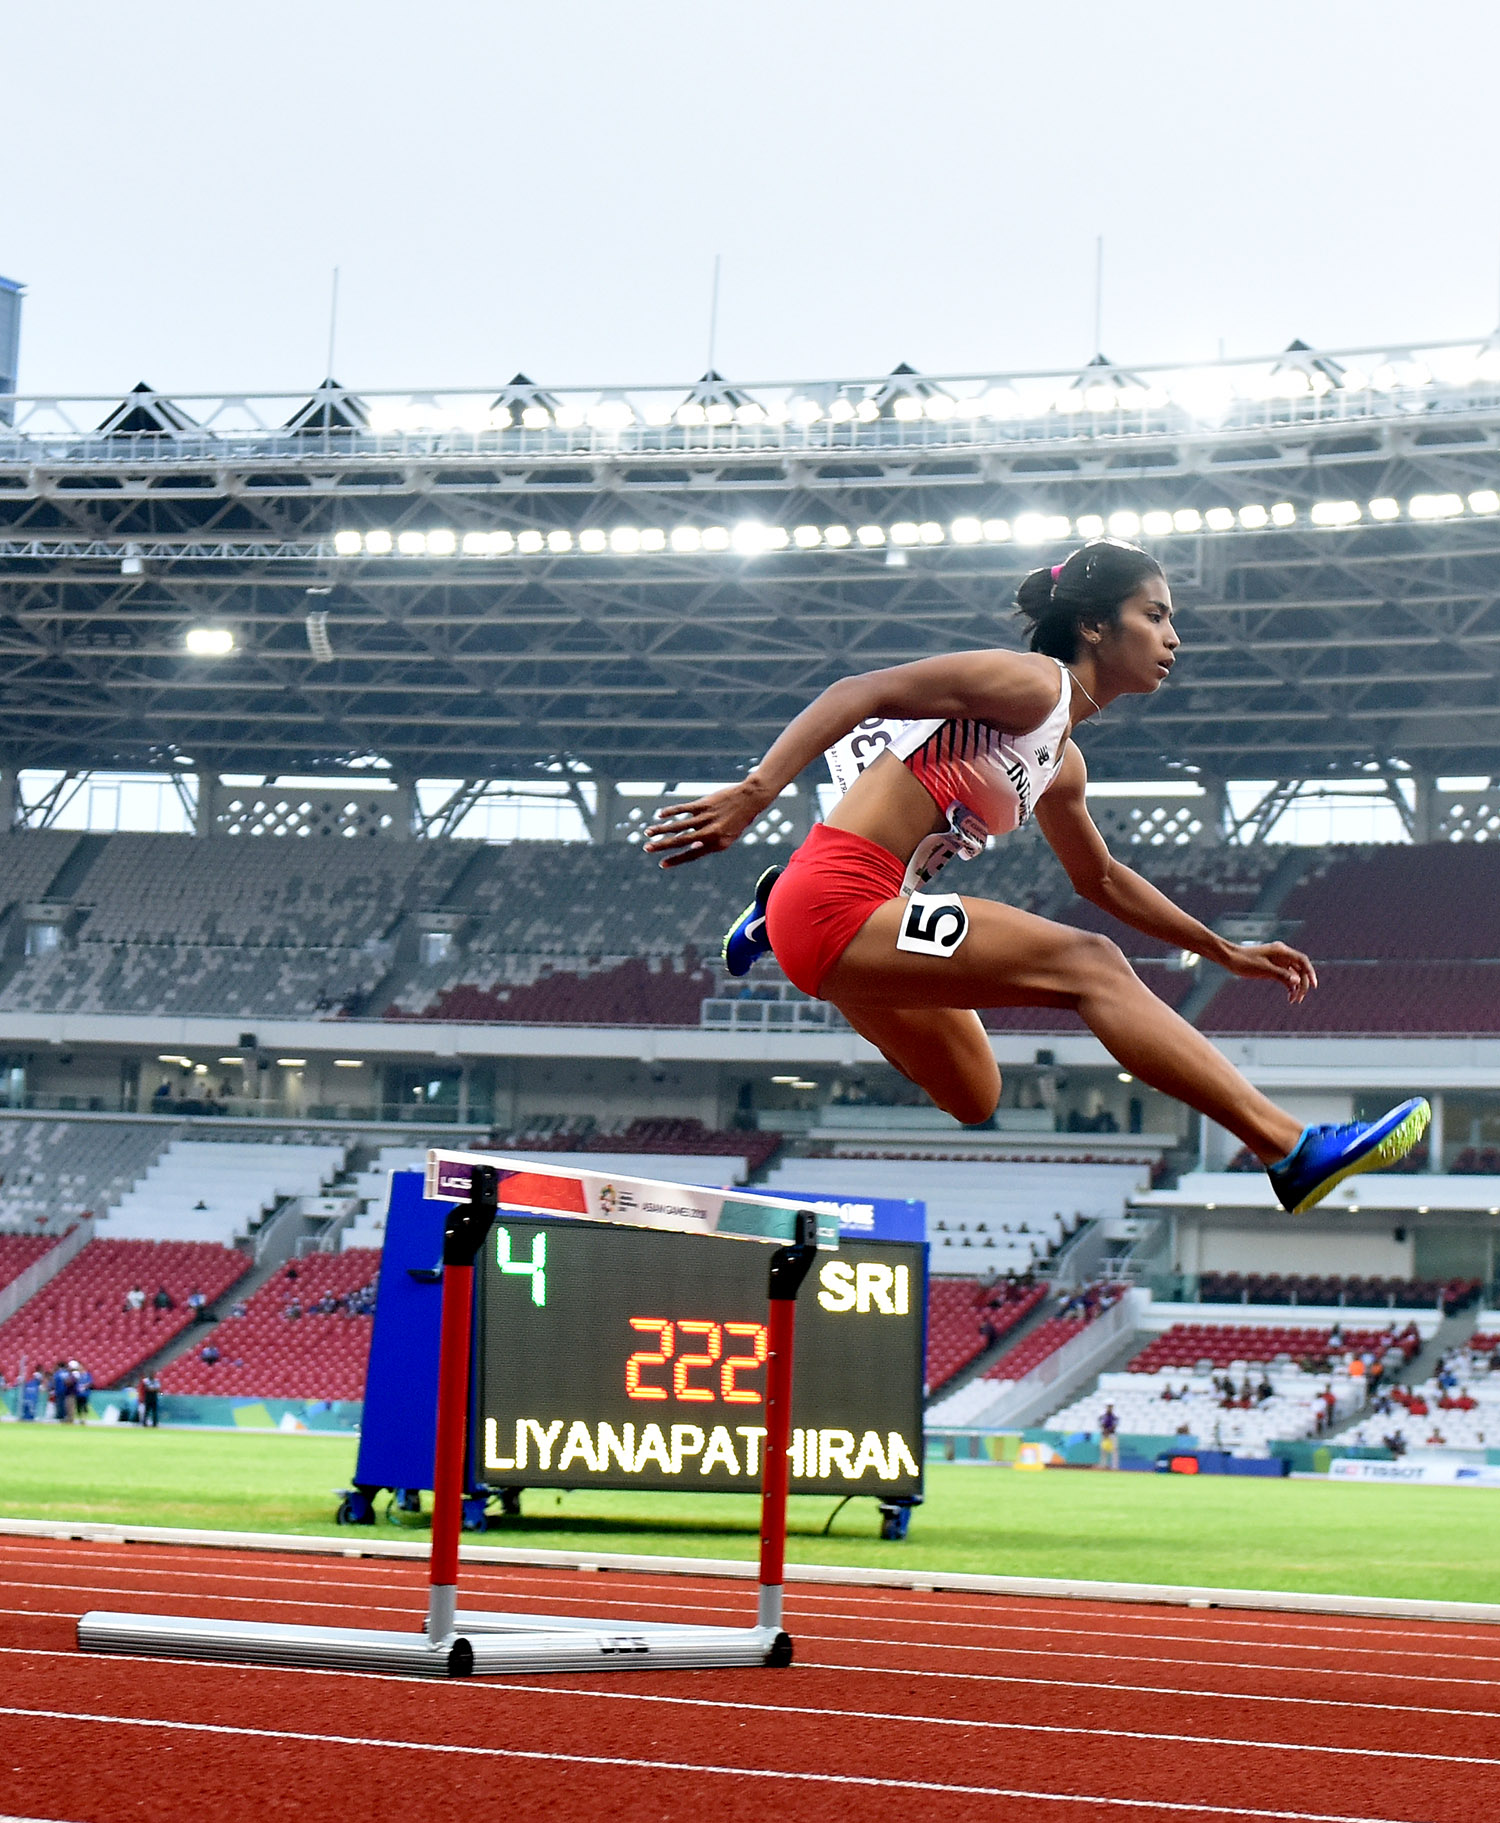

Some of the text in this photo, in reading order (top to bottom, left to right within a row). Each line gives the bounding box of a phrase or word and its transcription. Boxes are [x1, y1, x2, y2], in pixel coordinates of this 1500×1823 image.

[905, 904, 965, 947] 5
[497, 1227, 547, 1307] 4
[817, 1260, 909, 1315] SRI
[625, 1317, 768, 1404] 222
